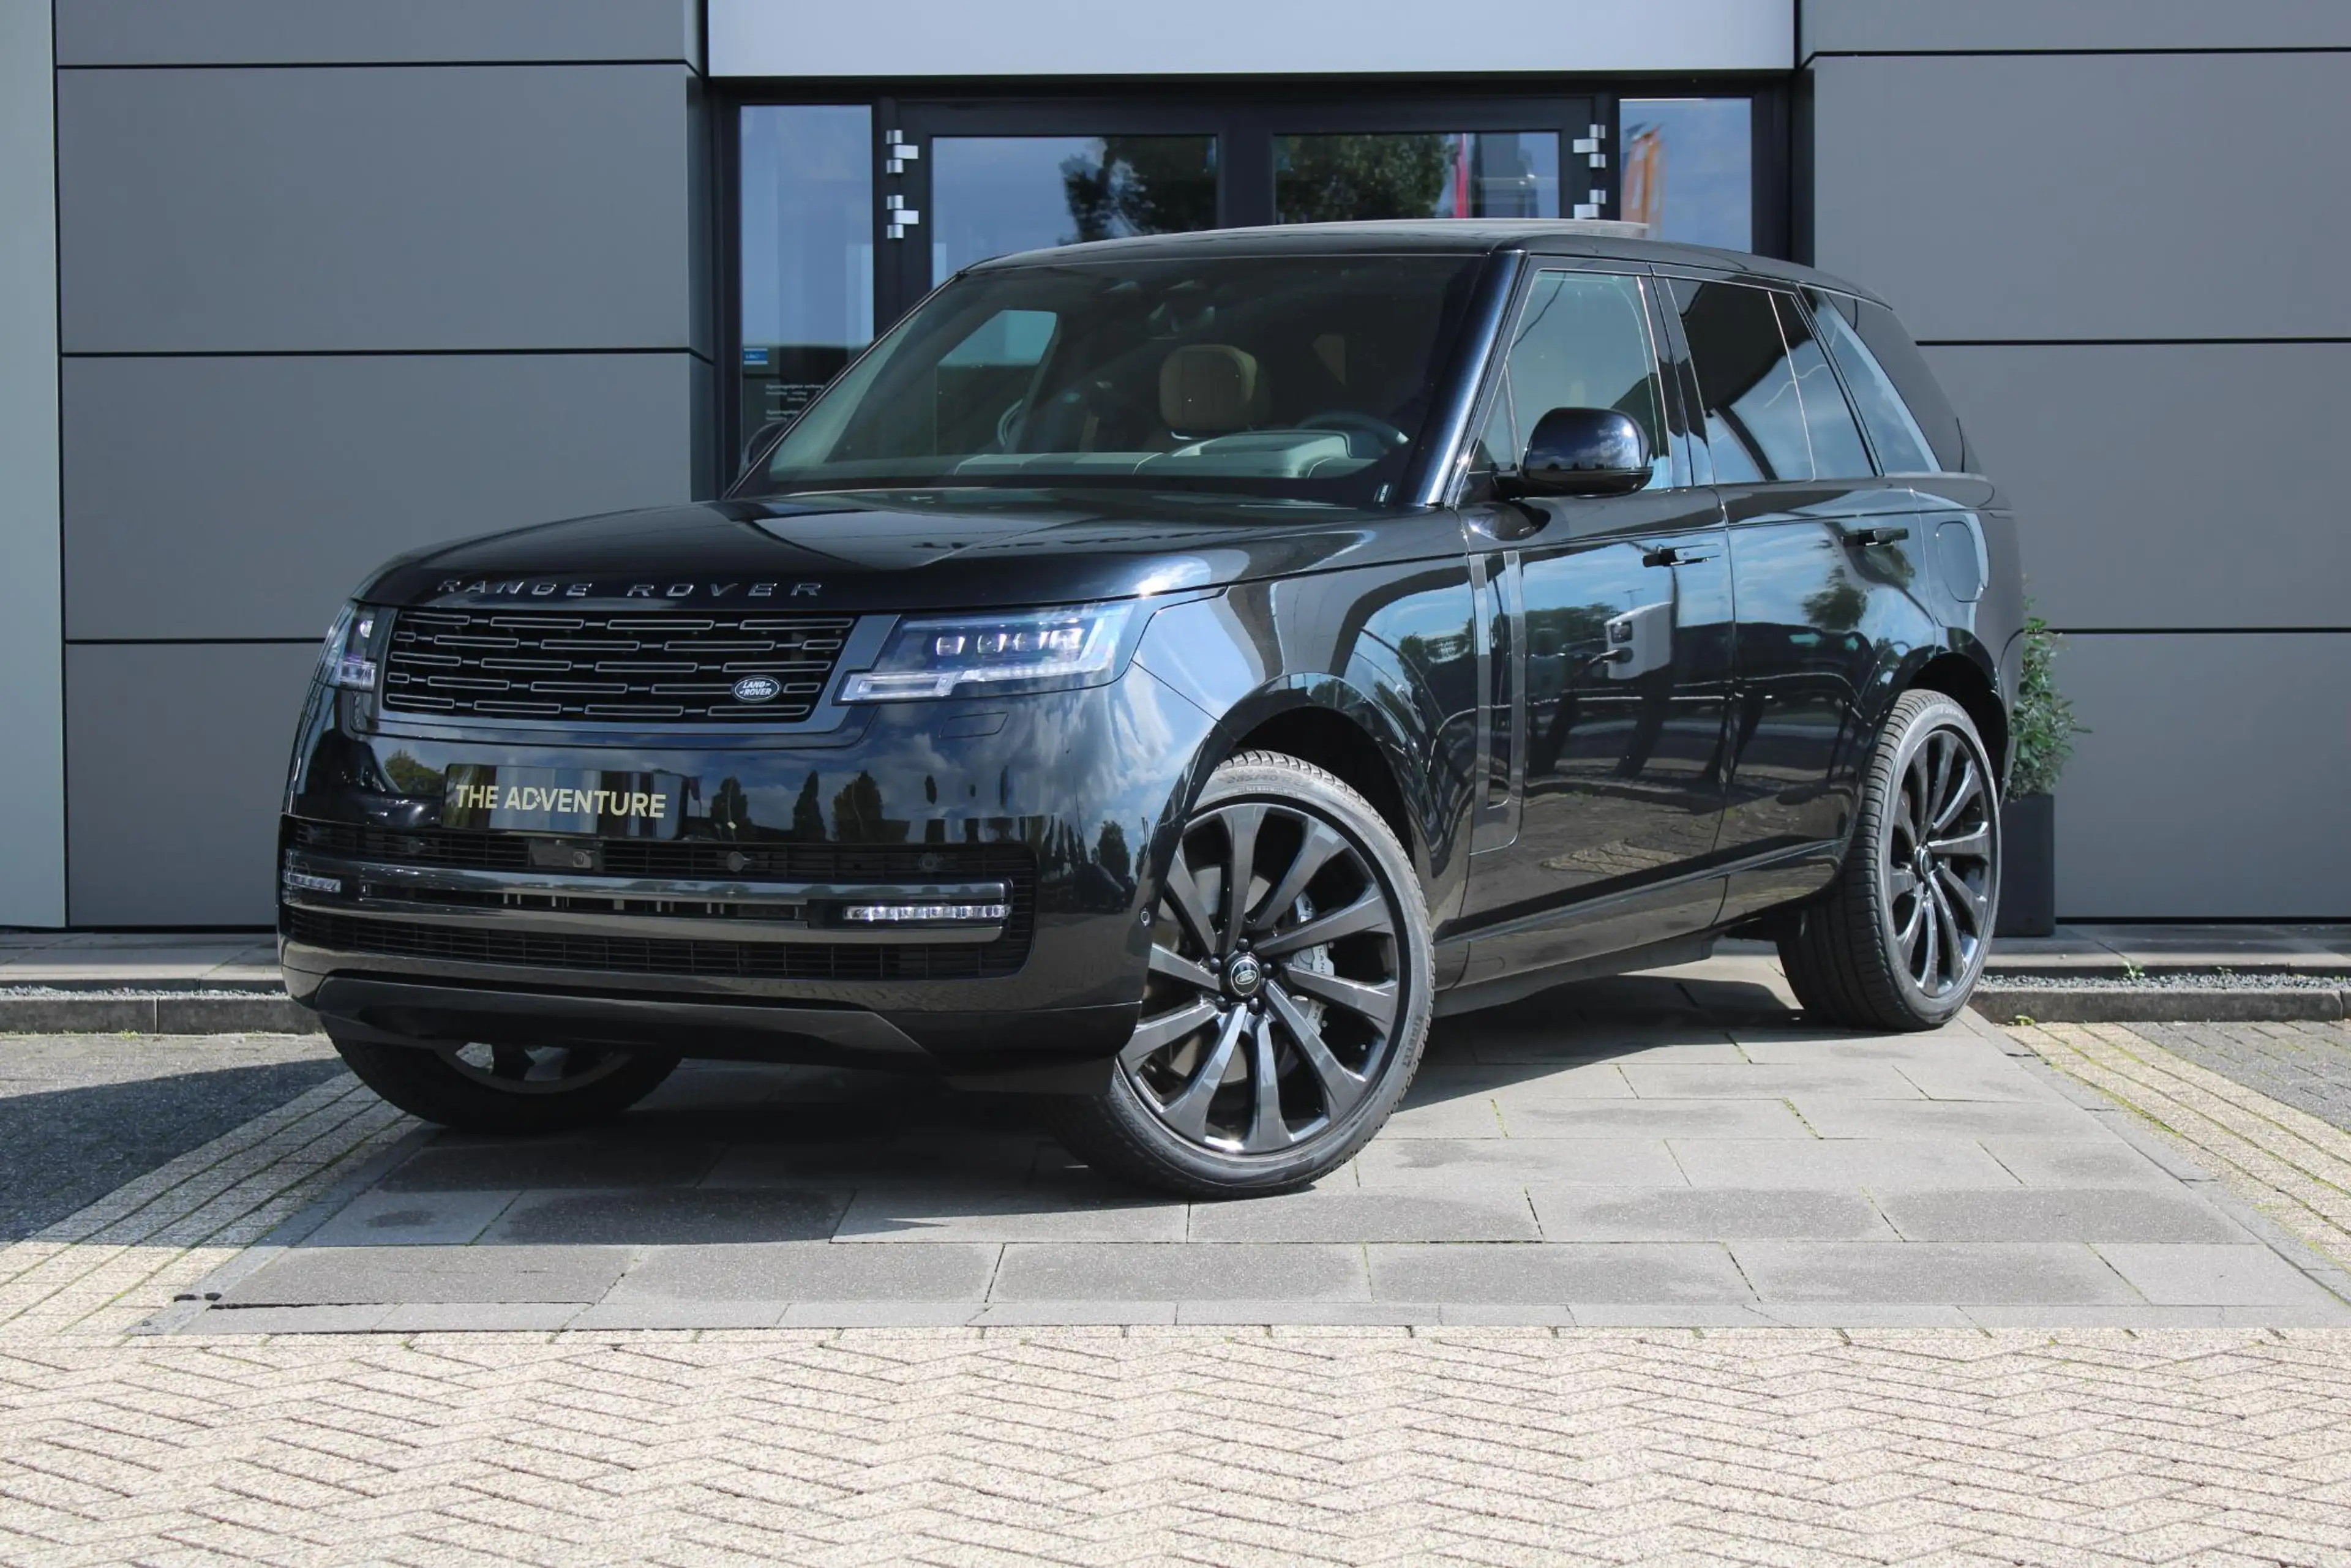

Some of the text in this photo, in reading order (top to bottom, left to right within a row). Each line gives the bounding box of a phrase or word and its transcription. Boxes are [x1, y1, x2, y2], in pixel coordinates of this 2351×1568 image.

[437, 580, 823, 597] RANGE ROVER
[456, 784, 667, 819] THE ADVENTURE
